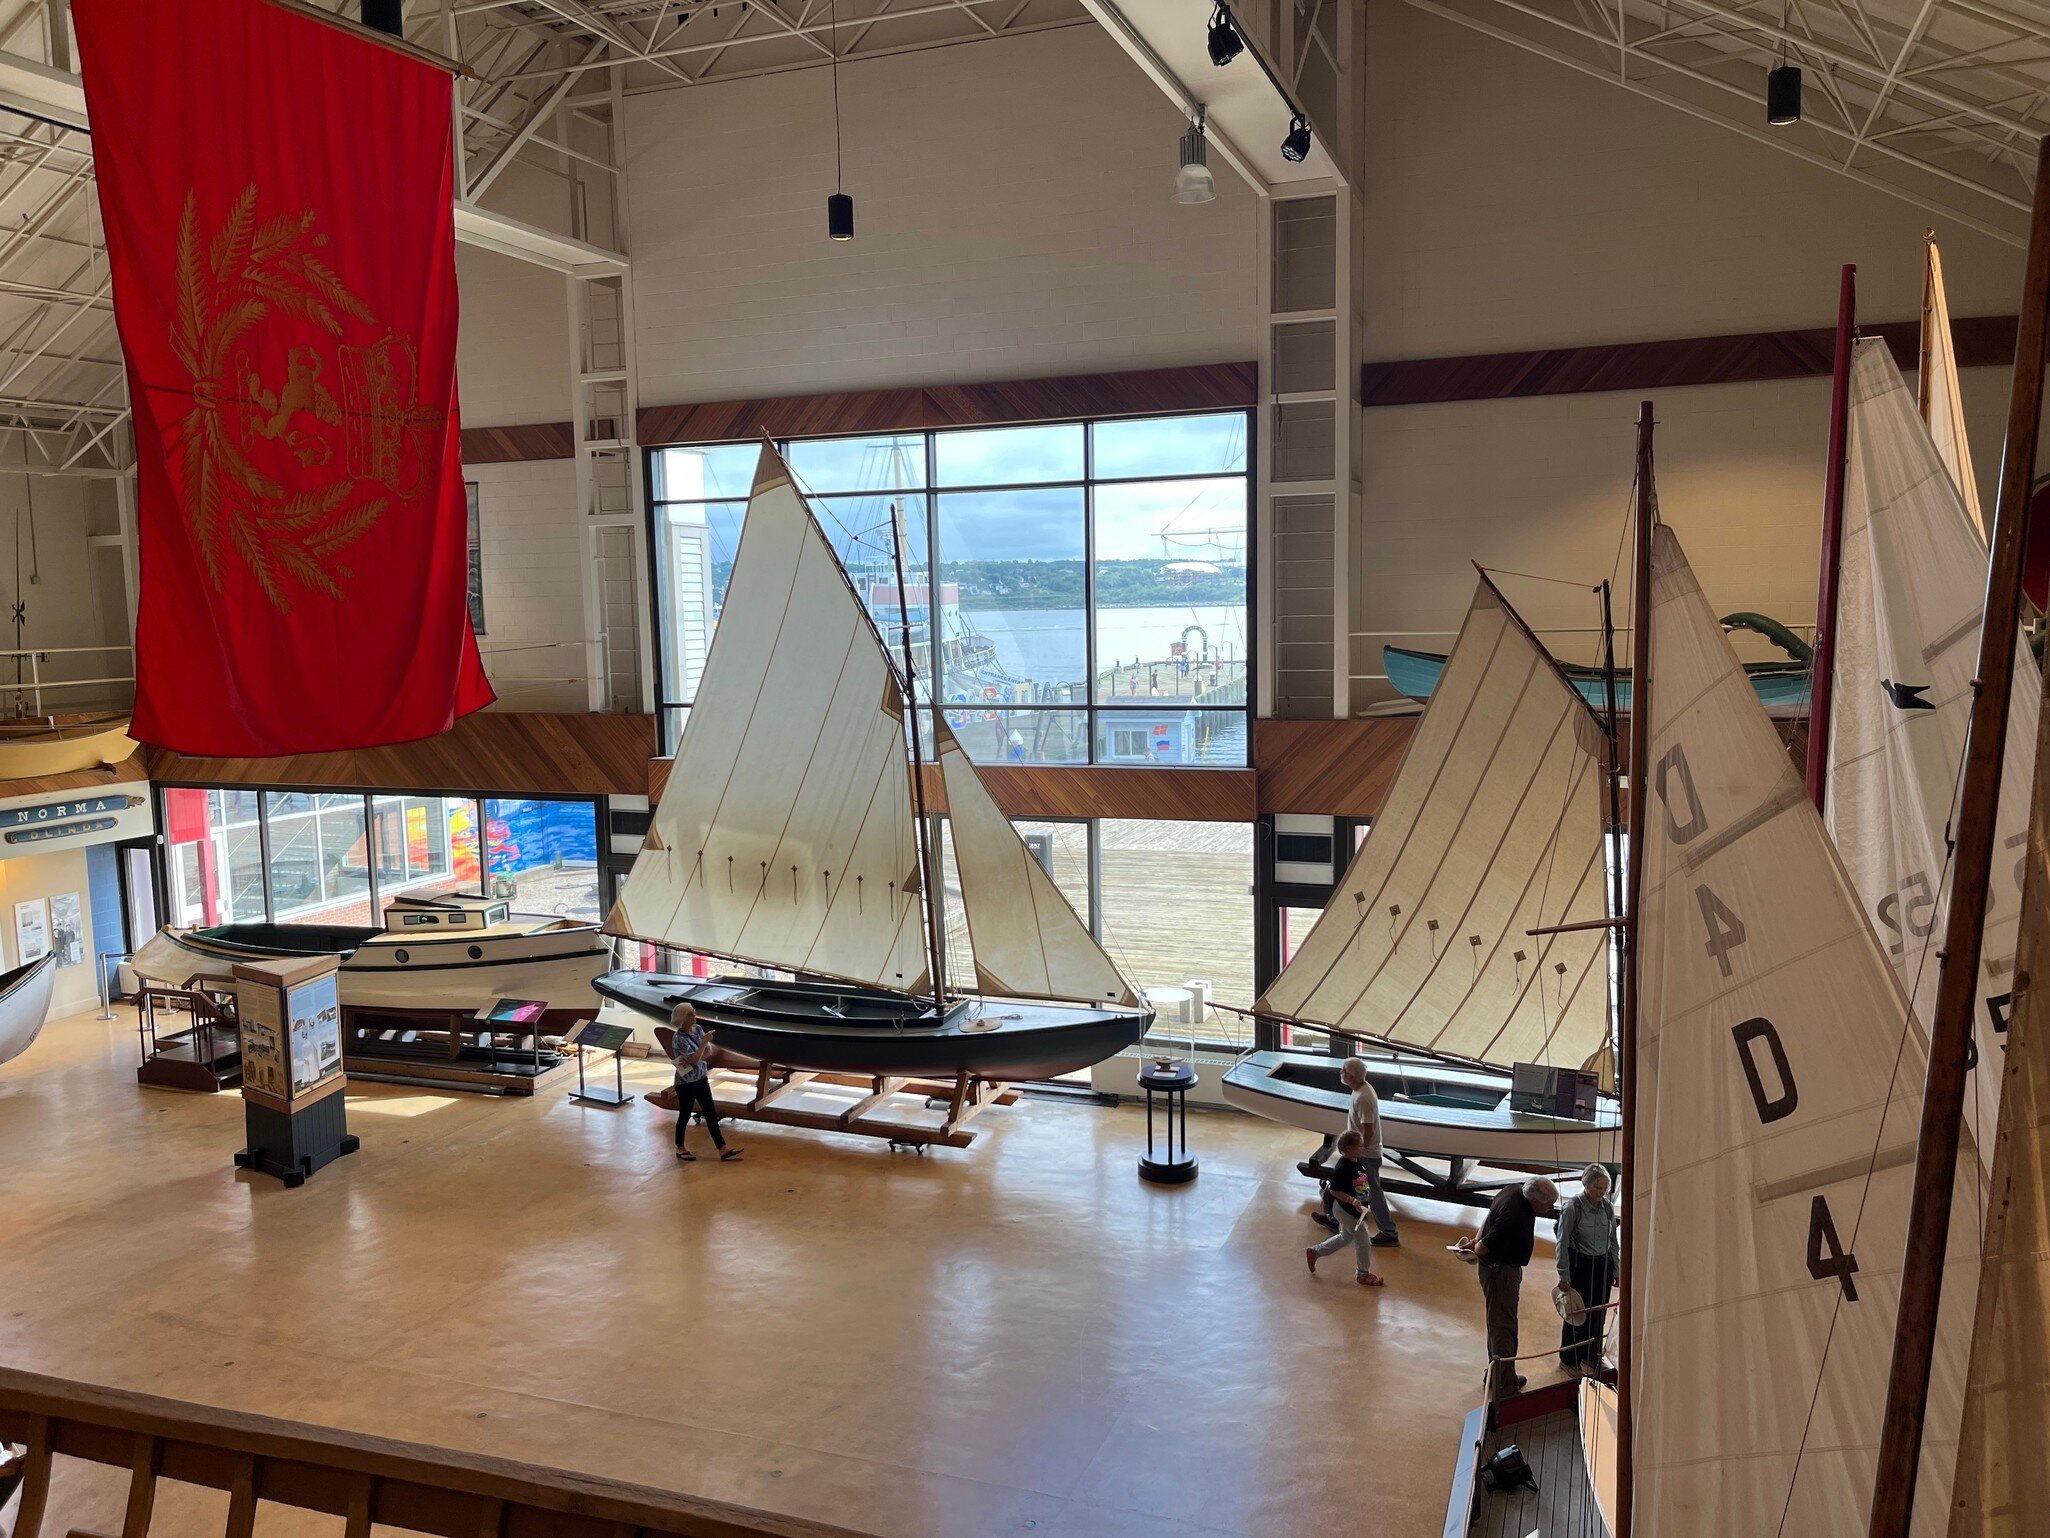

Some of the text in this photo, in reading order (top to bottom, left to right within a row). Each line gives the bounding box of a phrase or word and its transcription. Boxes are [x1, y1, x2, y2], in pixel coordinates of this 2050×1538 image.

[17, 800, 106, 822] NORMA
[30, 821, 105, 840] OLINDA
[1731, 1017, 1798, 1124] D
[1807, 1195, 1859, 1302] 4
